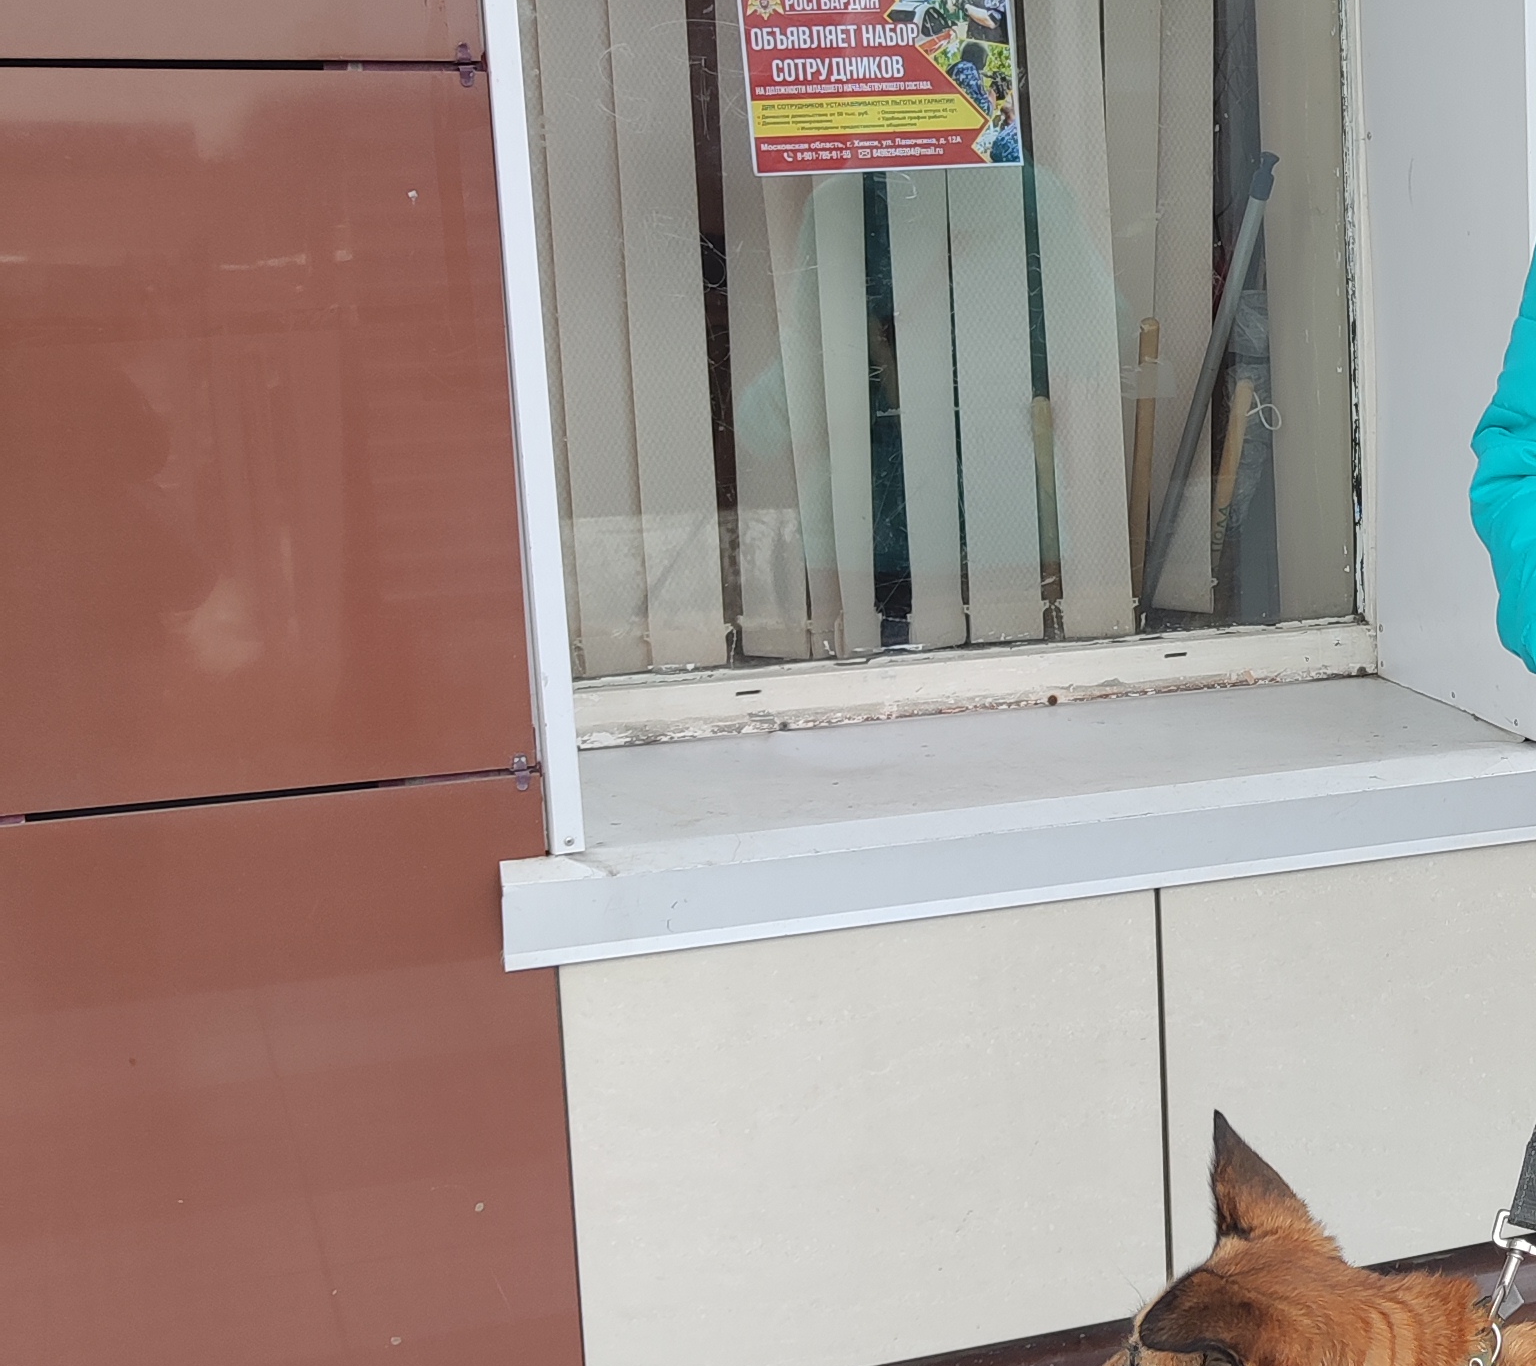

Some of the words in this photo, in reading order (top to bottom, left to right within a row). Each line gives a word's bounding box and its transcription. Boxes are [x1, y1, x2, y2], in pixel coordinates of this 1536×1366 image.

[751, 25, 858, 51] ОБЪЯВЛЯЕТ
[861, 23, 918, 47] НАБОР
[772, 56, 905, 82] СОТРУДНИКОВ
